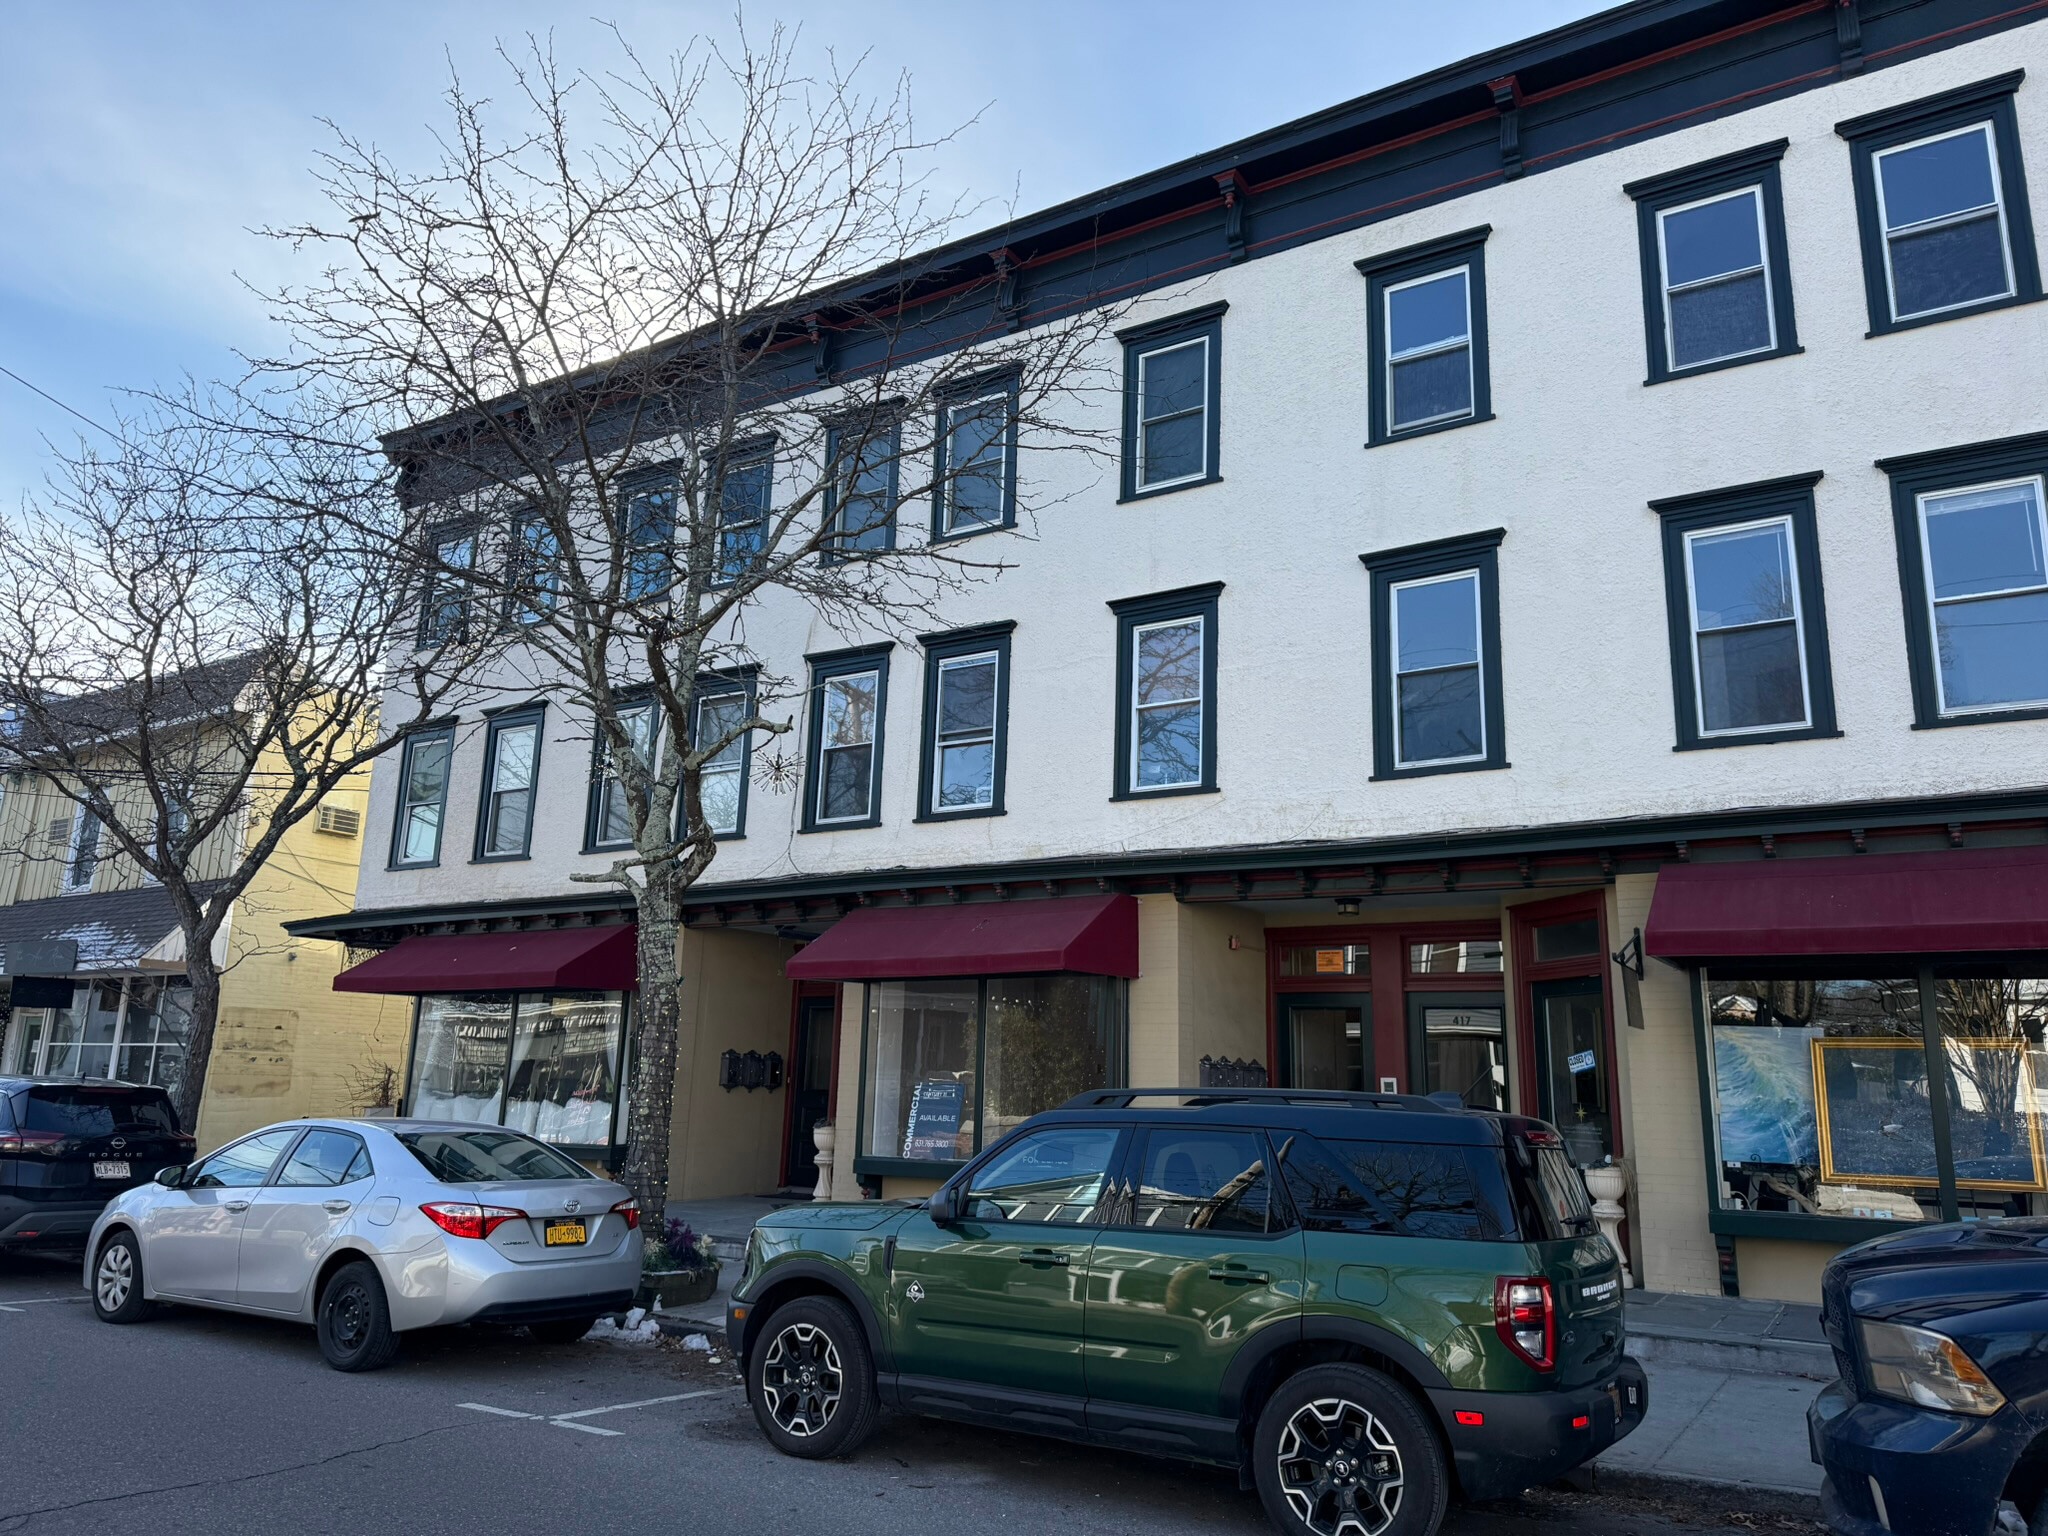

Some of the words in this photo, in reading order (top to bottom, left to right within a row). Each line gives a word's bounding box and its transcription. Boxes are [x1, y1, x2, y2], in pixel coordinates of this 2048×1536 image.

[1452, 1015, 1471, 1025] 417
[1569, 1054, 1584, 1066] CLOSED
[903, 1082, 922, 1158] COMMERCIAL
[919, 1114, 956, 1122] AVAILABLE
[1582, 1279, 1617, 1297] BRONCO
